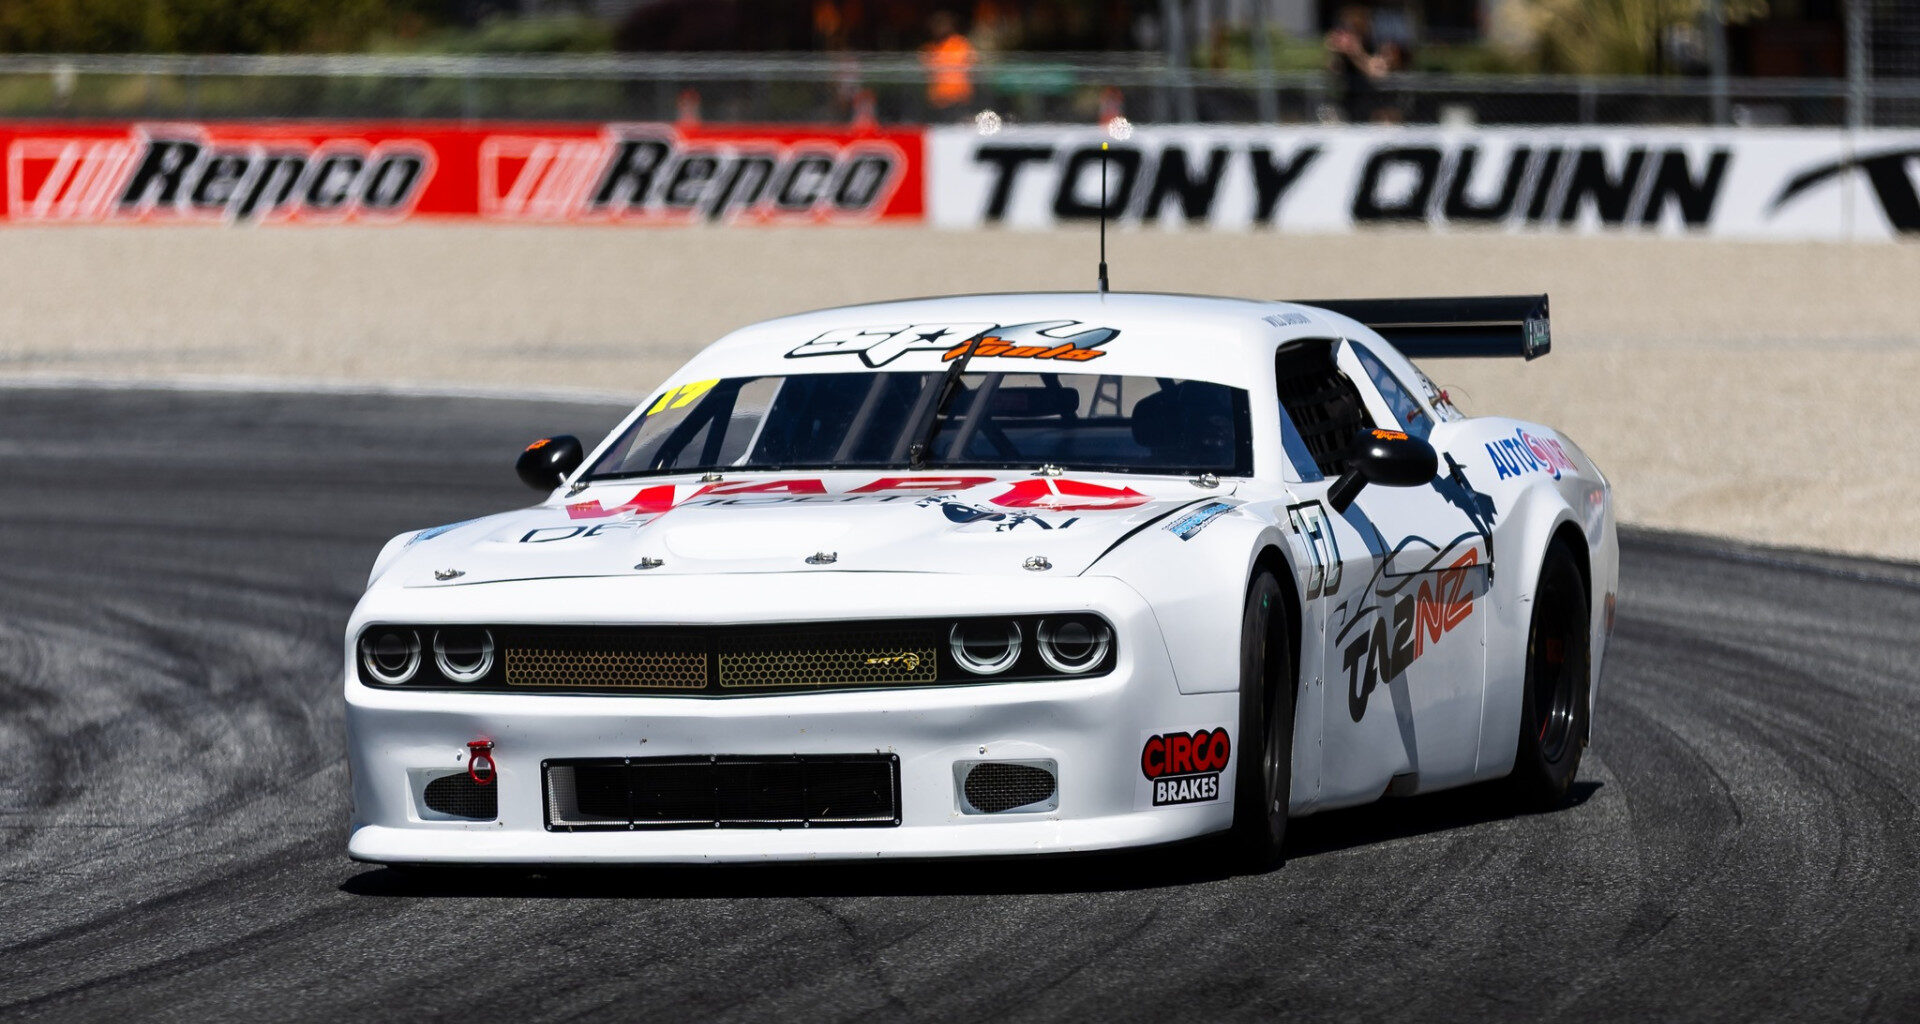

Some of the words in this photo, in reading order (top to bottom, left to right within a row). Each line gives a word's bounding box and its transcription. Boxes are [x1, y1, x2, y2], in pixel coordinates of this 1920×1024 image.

[118, 139, 426, 223] Repco
[594, 139, 891, 223] Repco
[974, 146, 1323, 222] TONY
[1350, 145, 1733, 224] QUINN
[647, 378, 721, 417] 17
[1141, 727, 1231, 782] CIRCO
[1156, 776, 1217, 803] BRAKES
